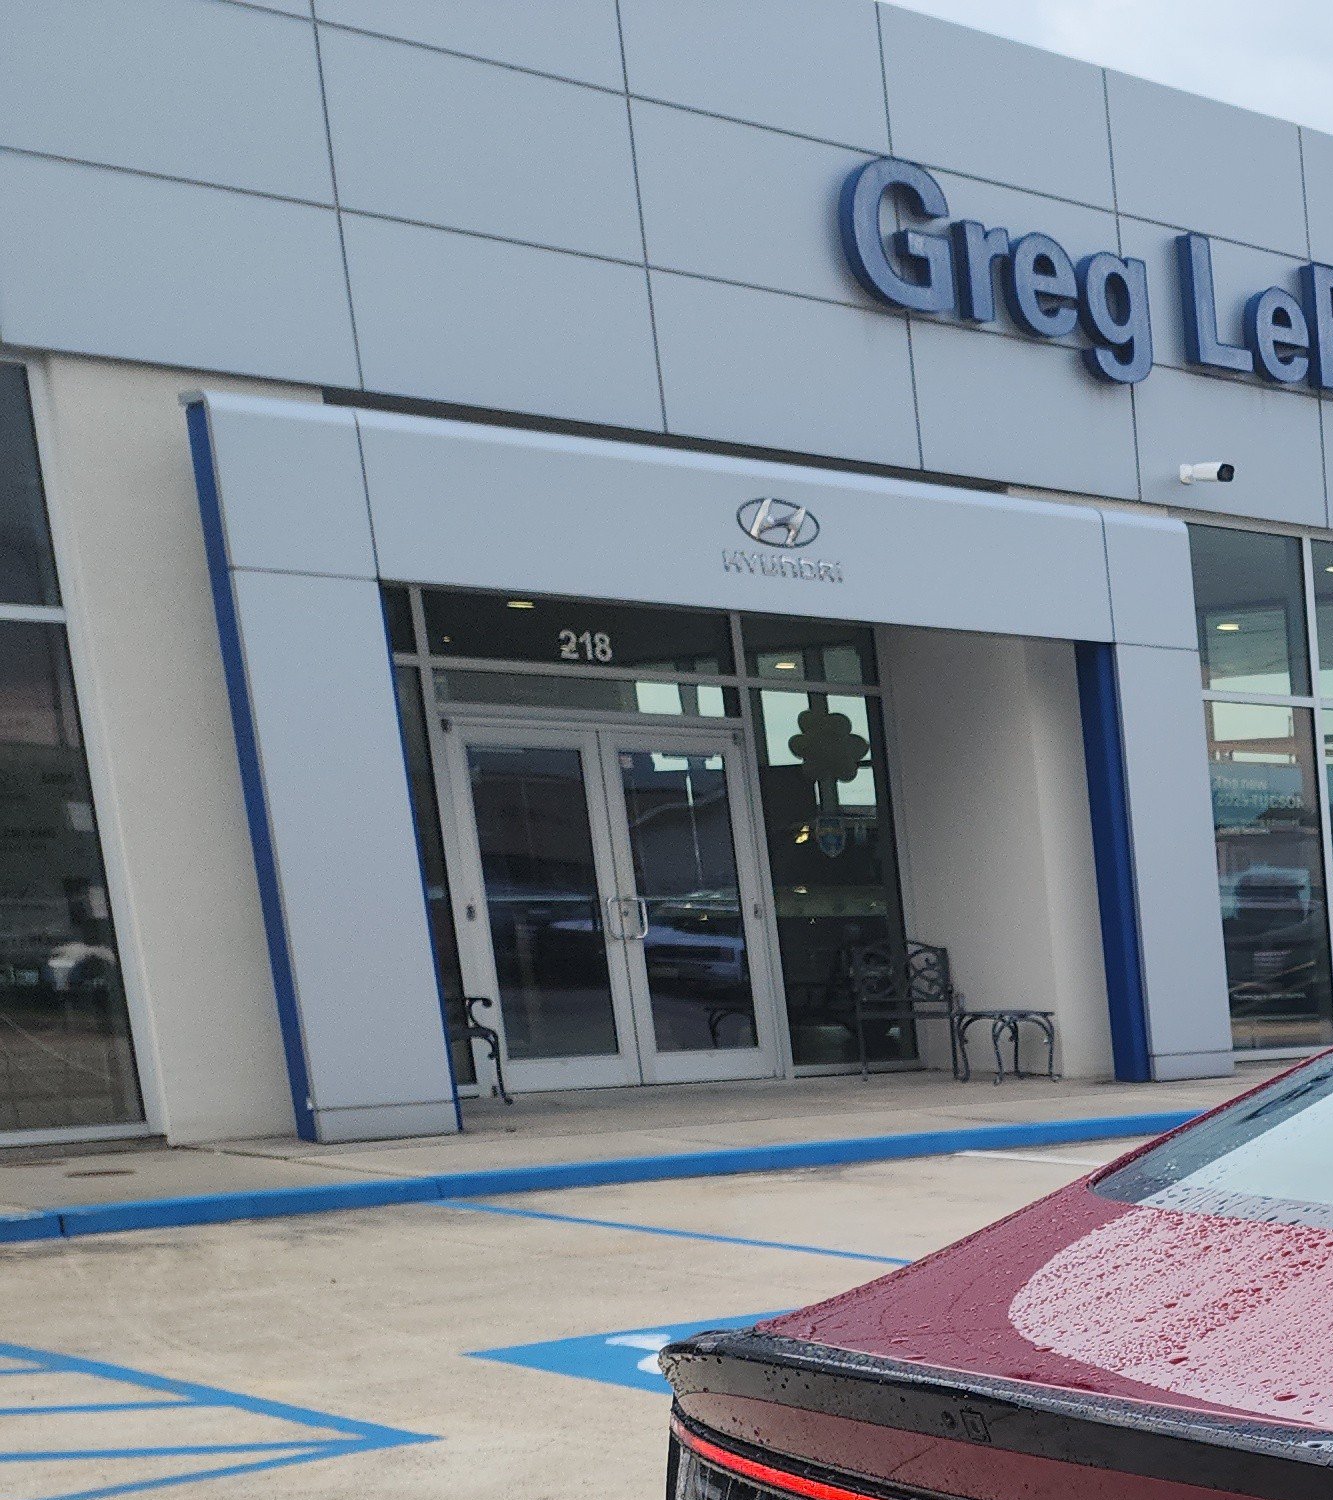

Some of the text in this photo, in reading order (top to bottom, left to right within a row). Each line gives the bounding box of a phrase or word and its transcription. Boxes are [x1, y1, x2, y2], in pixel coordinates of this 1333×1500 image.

[838, 156, 1153, 385] Greg
[722, 549, 843, 583] HYUNDAI
[559, 629, 612, 662] 218
